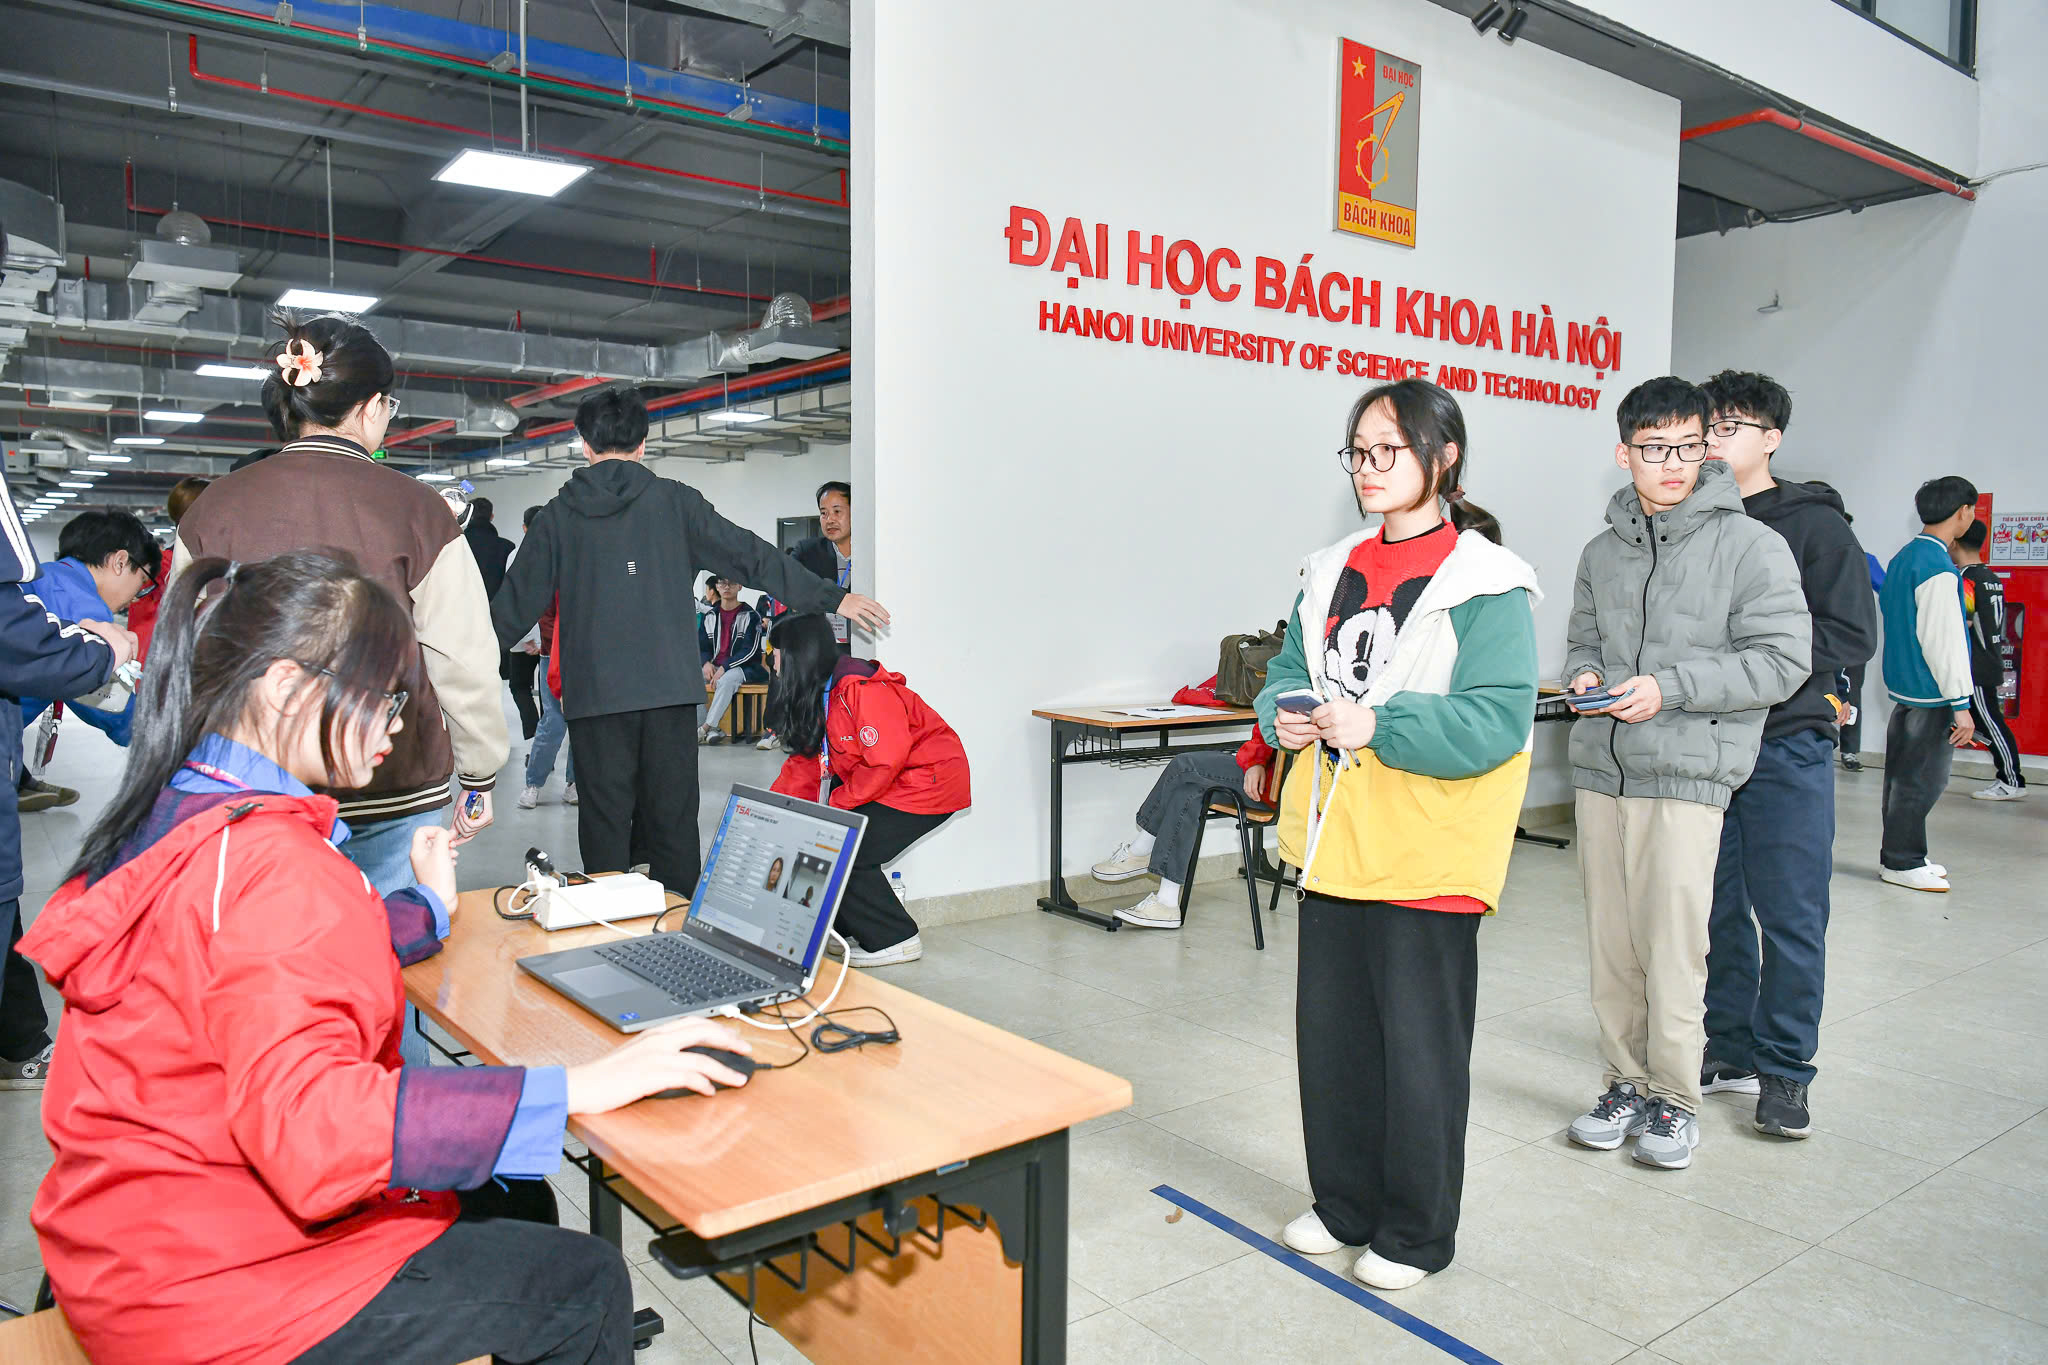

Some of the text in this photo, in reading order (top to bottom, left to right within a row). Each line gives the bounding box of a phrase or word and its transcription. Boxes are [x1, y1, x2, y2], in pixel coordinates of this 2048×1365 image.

[1383, 65, 1414, 88] ĐẠI HỌC
[1344, 200, 1411, 237] BÁCH KHOA
[1004, 205, 1622, 380] ĐẠI HỌC BÁCH KHOA HÀ NỘI
[1039, 300, 1134, 343] HANOI
[1142, 316, 1296, 366] UNIVERSITY
[1299, 343, 1333, 371] OF
[1435, 365, 1477, 392] AND
[1482, 371, 1601, 411] TECHNOLOGY
[736, 804, 750, 816] TSA
